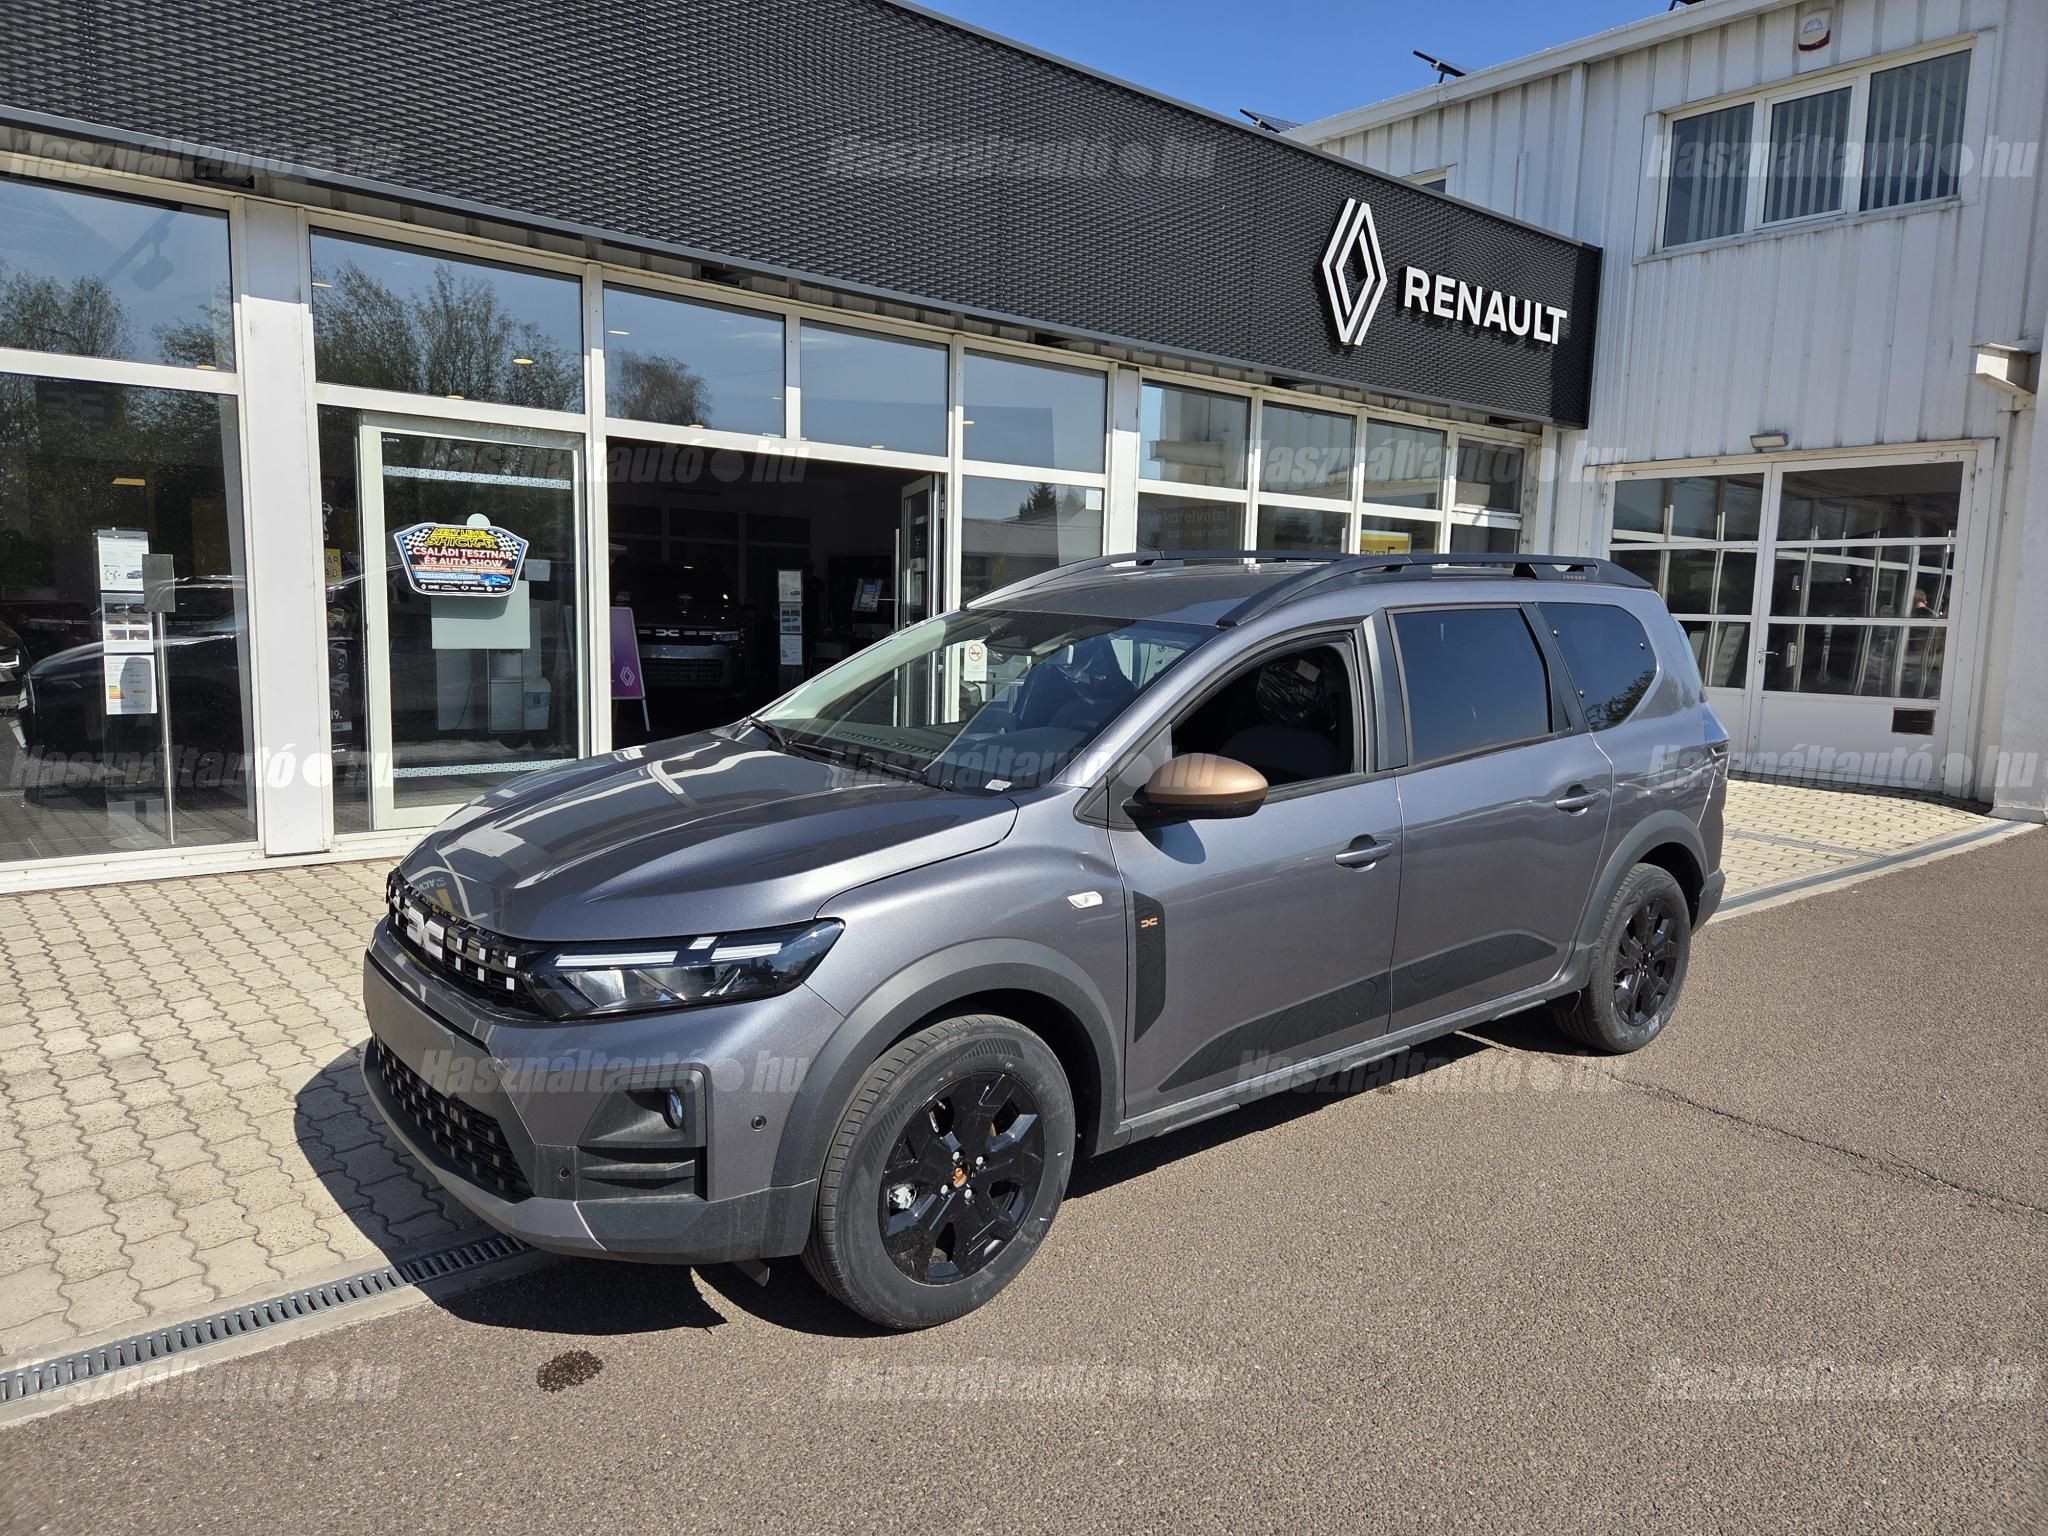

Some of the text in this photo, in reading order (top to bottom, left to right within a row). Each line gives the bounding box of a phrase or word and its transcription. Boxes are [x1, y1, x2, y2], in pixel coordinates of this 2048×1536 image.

[1404, 266, 1567, 344] RENAULT
[412, 546, 513, 560] CSALÁDI TESZTNAP
[424, 553, 503, 568] ÉS AUTÓ SHOW
